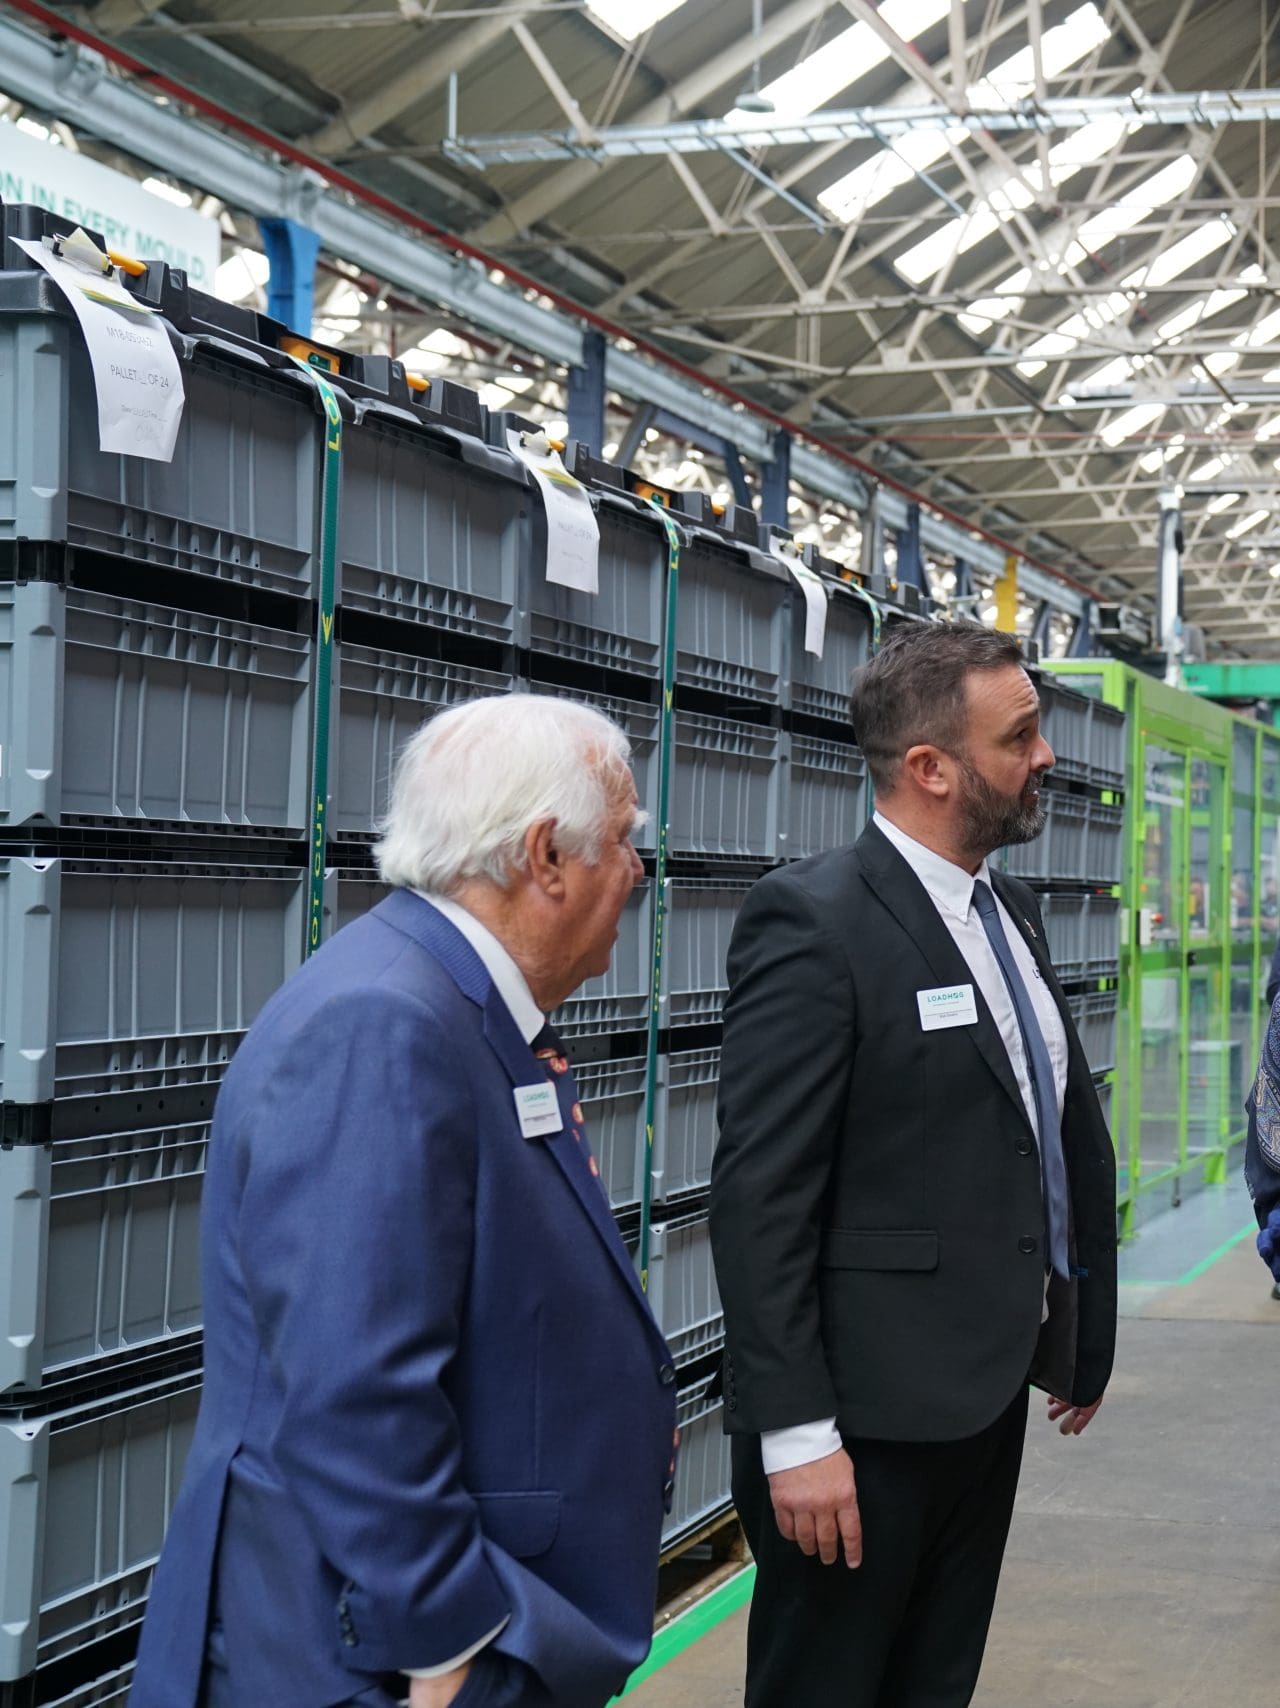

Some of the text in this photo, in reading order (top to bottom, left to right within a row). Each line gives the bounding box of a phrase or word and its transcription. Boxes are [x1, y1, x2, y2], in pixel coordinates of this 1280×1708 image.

[32, 182, 57, 213] IN
[63, 196, 130, 248] EVERY
[110, 363, 169, 389] PALLET OF 24
[314, 795, 324, 878] CUT
